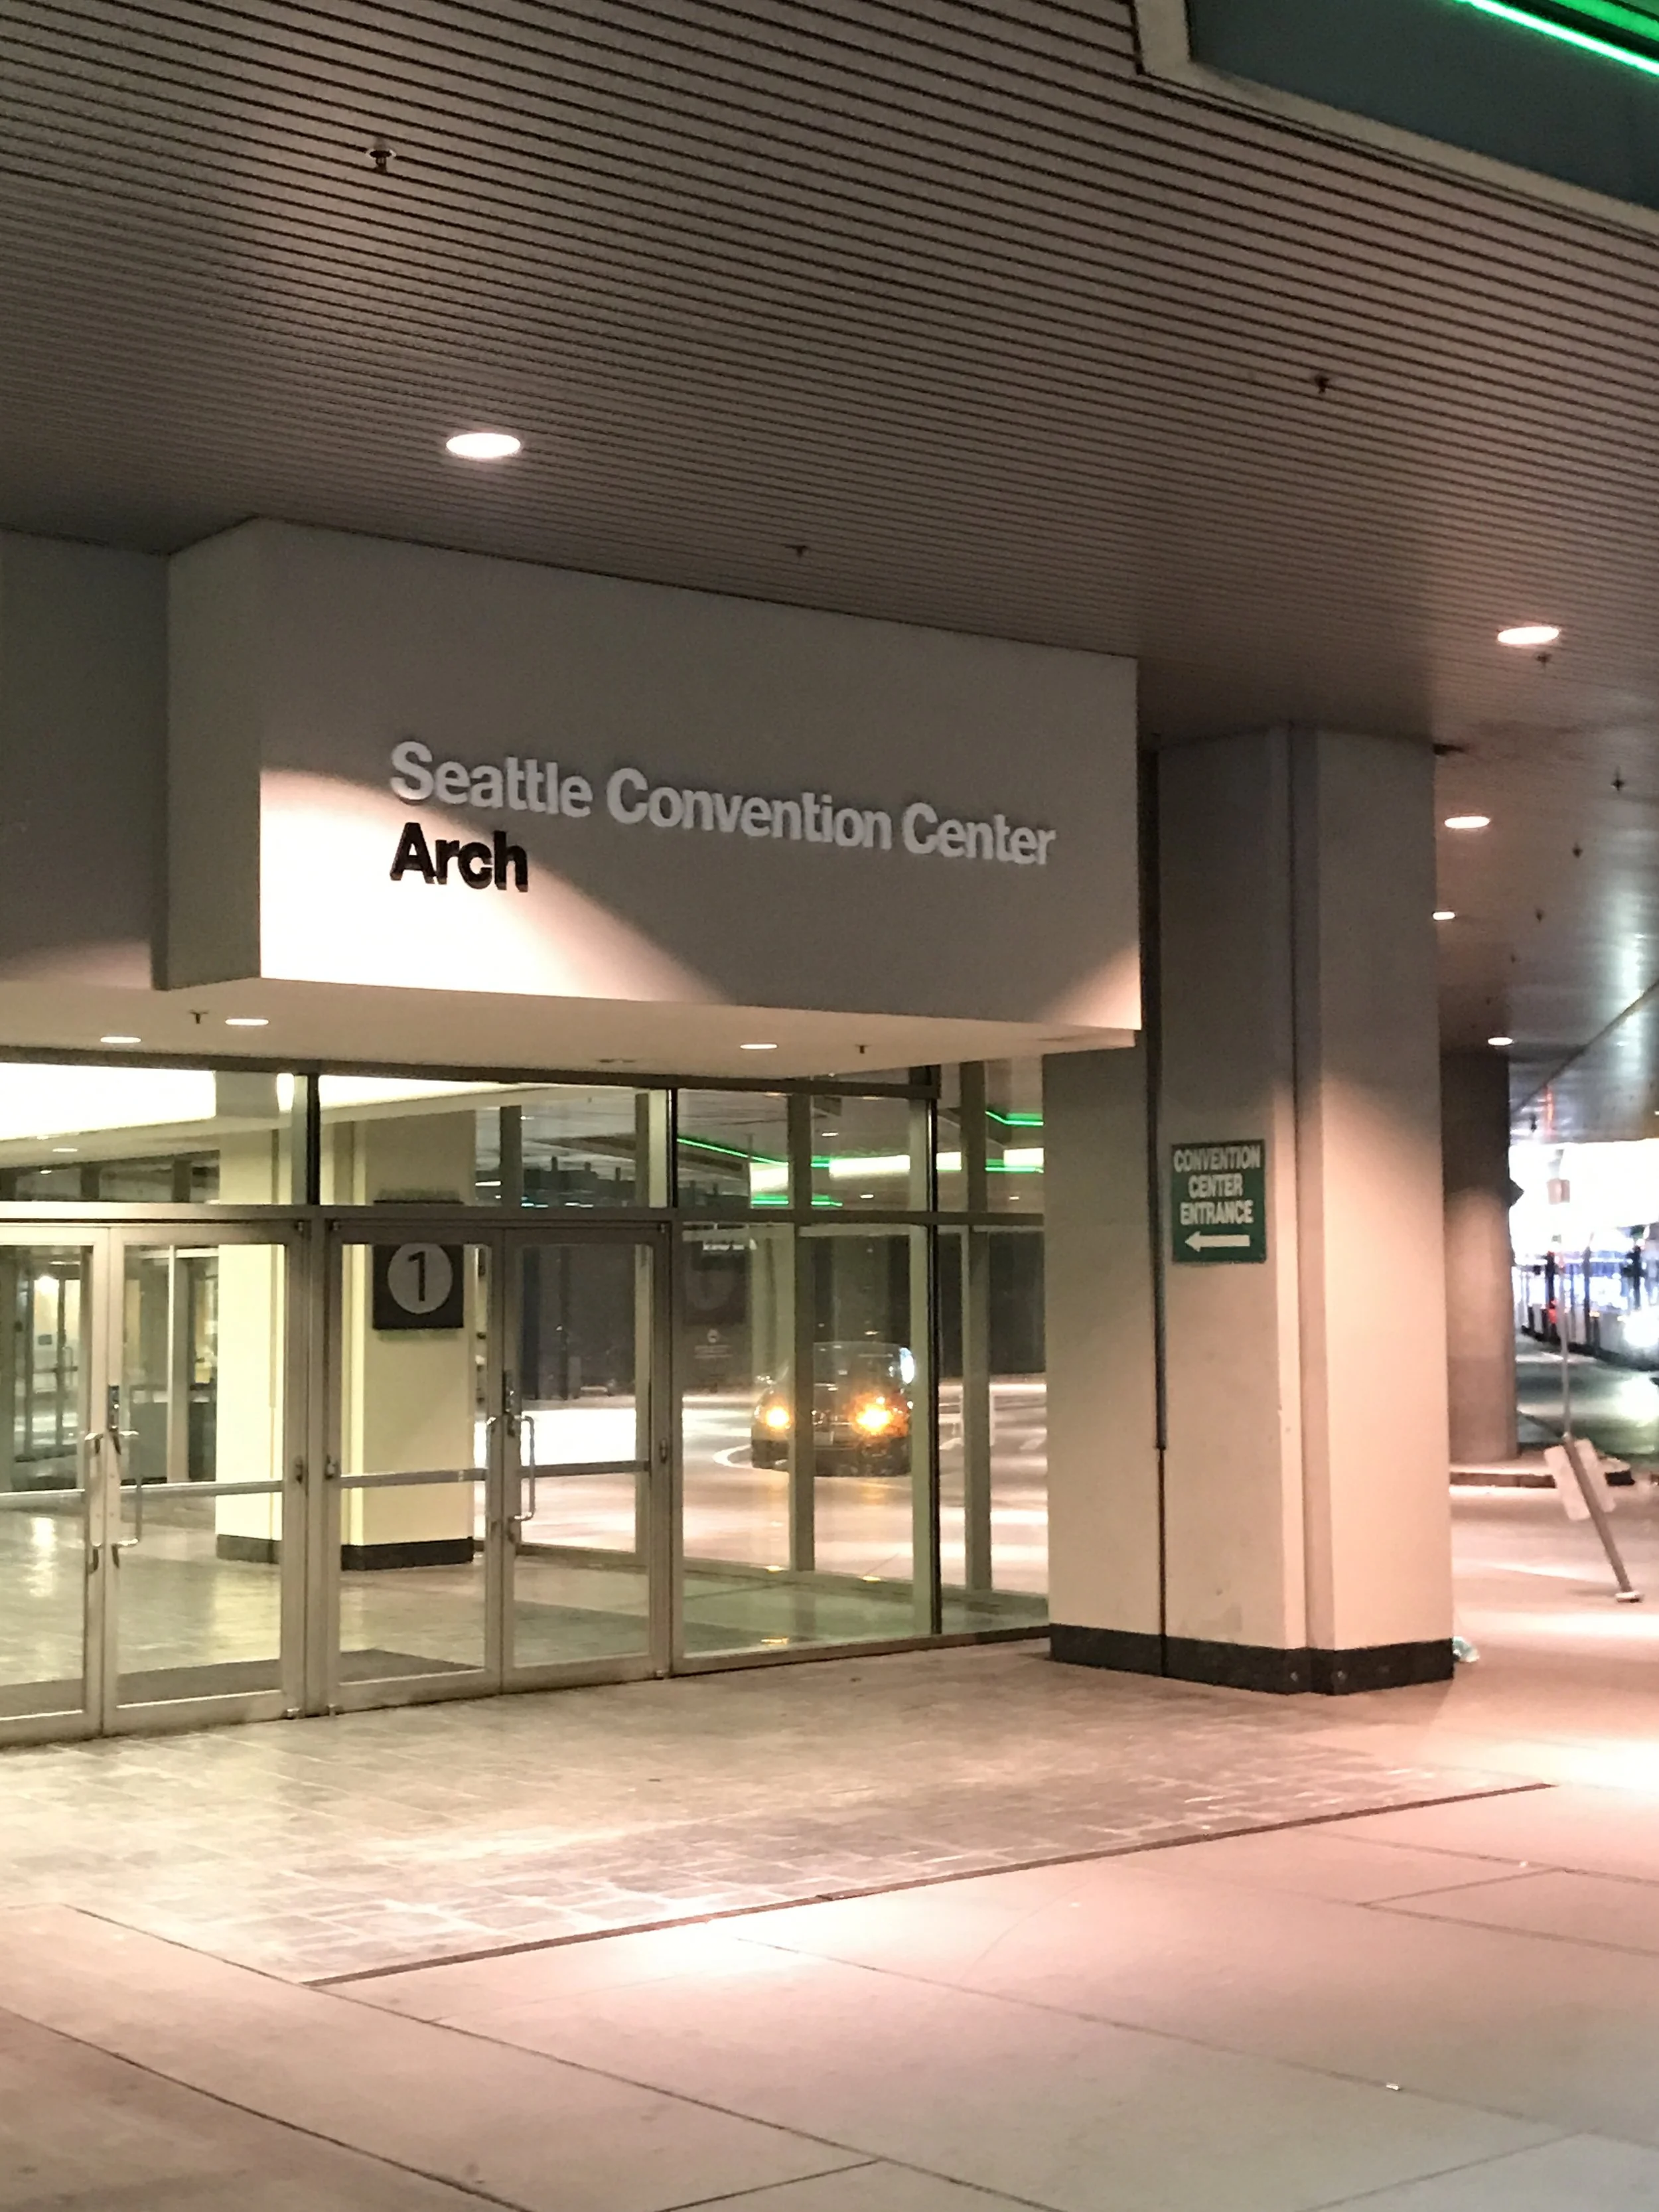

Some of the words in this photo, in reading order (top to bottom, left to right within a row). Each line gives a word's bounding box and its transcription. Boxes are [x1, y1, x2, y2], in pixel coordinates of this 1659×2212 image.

[390, 741, 593, 818] Seattle
[607, 768, 892, 849] Convention
[902, 802, 1056, 865] Center
[390, 822, 528, 892] Arch
[1173, 1145, 1260, 1172] CONVENTION
[1189, 1173, 1244, 1198] CENTER
[1180, 1199, 1254, 1225] ENTRANCE
[408, 1251, 425, 1301] 1
